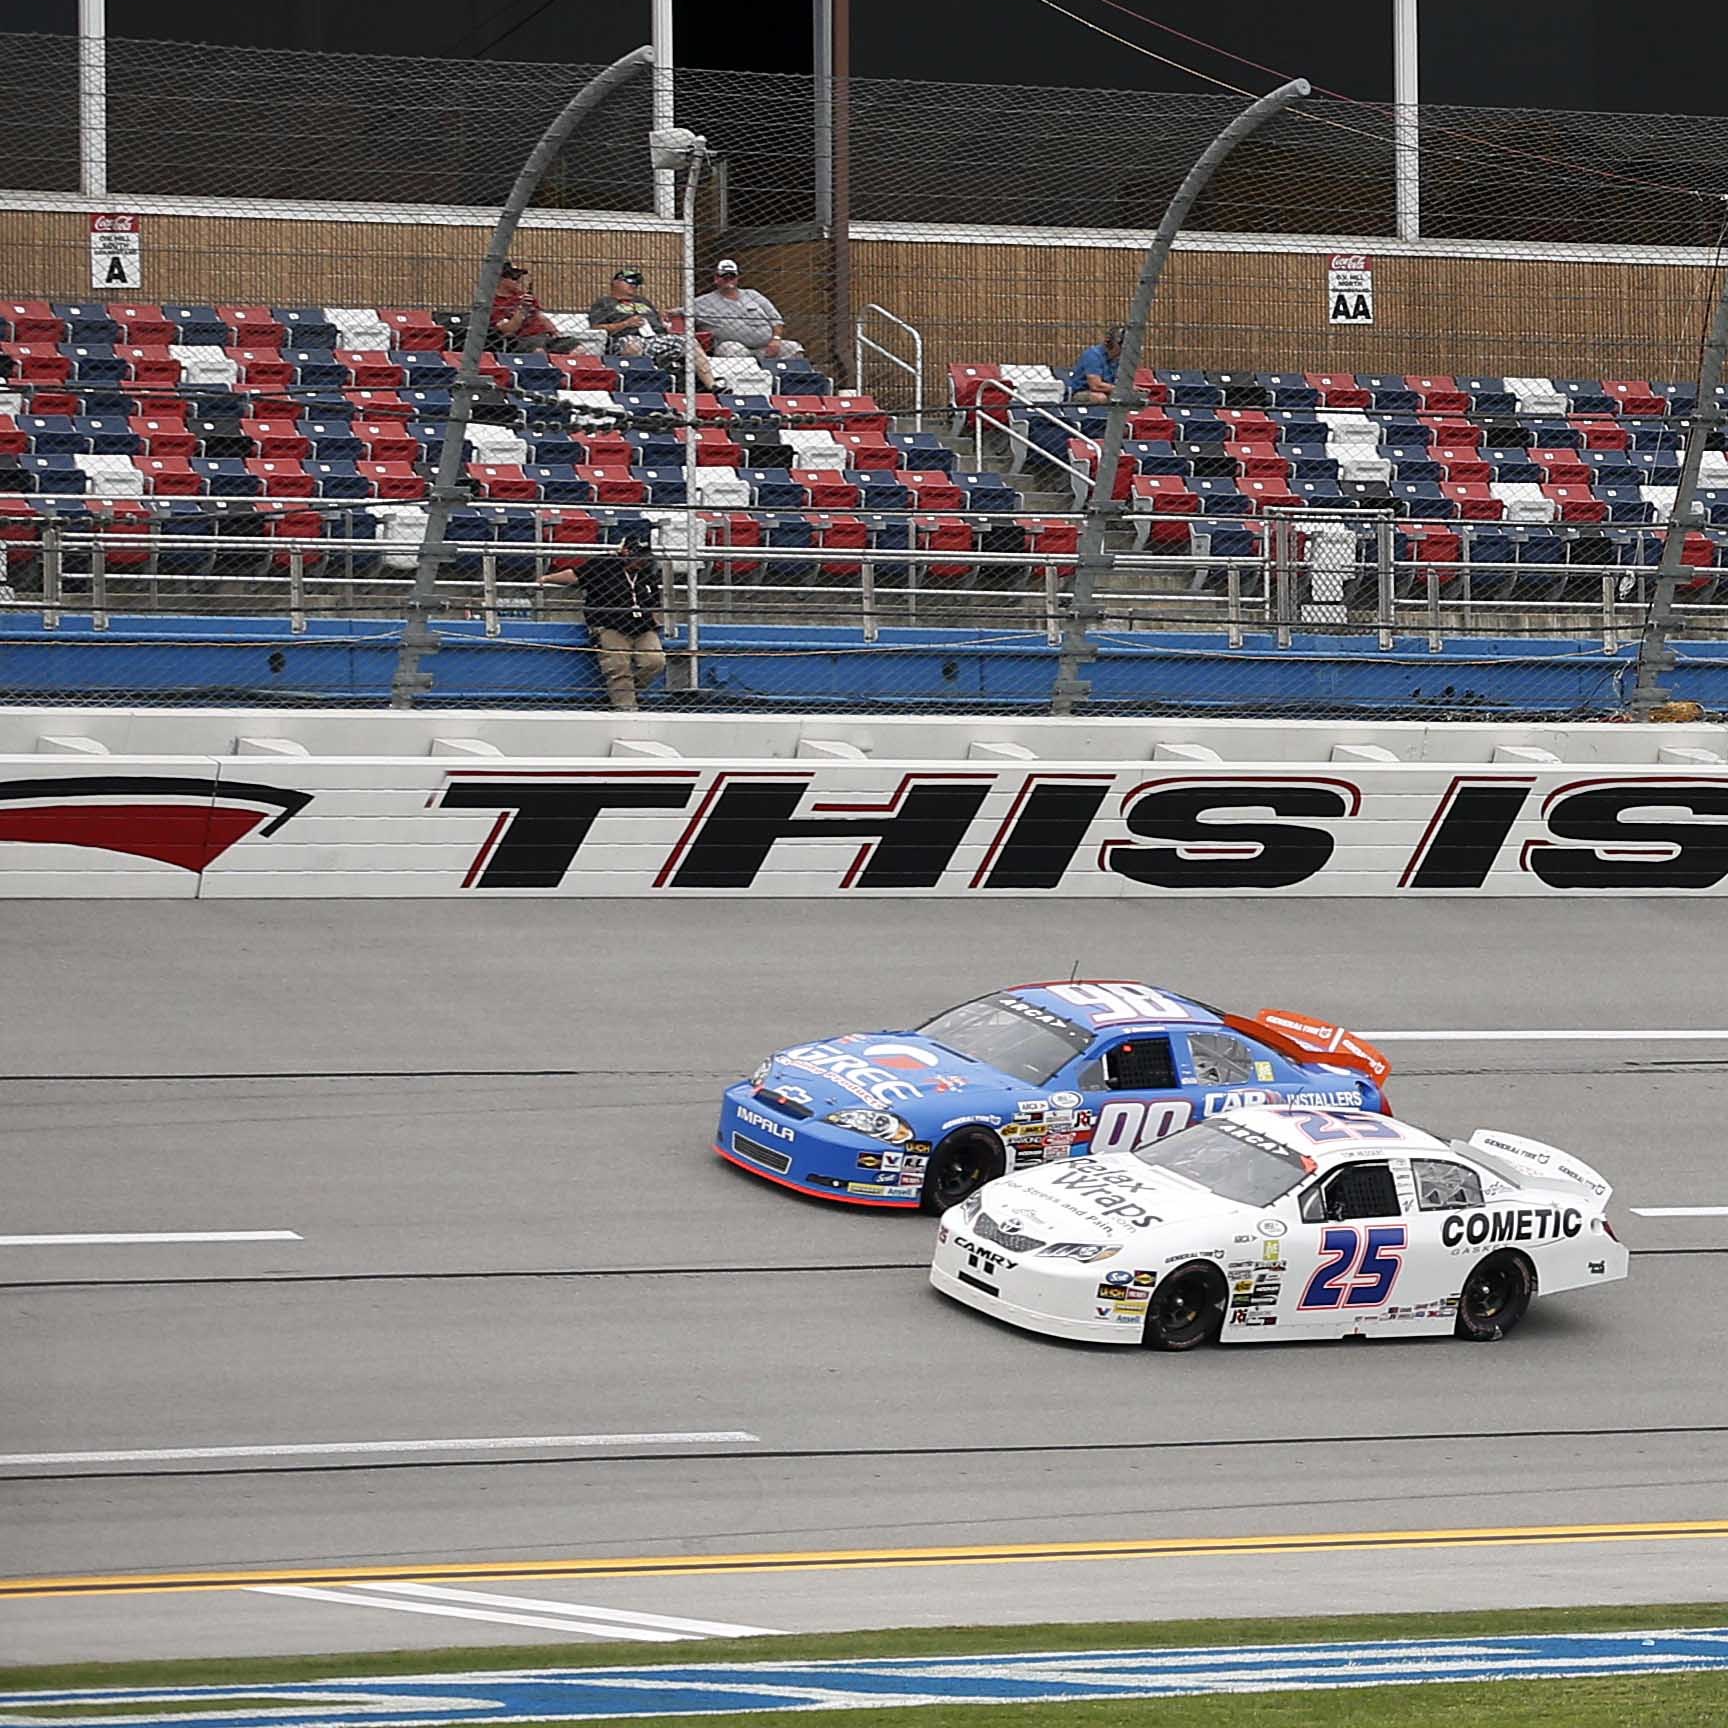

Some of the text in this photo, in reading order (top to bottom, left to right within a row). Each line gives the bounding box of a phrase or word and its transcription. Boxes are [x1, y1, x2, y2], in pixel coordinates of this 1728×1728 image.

[106, 256, 128, 283] A
[1332, 294, 1371, 319] AA
[427, 771, 1363, 889] THIS
[1000, 999, 1057, 1025] ARCA
[788, 1044, 925, 1106] GREE
[1287, 1091, 1363, 1107] INSTALLERS
[736, 1105, 795, 1143] IMPALA
[1218, 1124, 1280, 1153] ARCA
[1056, 1158, 1158, 1193] Relax
[1051, 1171, 1163, 1228] Wraps
[1442, 1207, 1583, 1248] COMETIC
[953, 1236, 1019, 1270] CAMRY
[1296, 1223, 1408, 1311] 25
